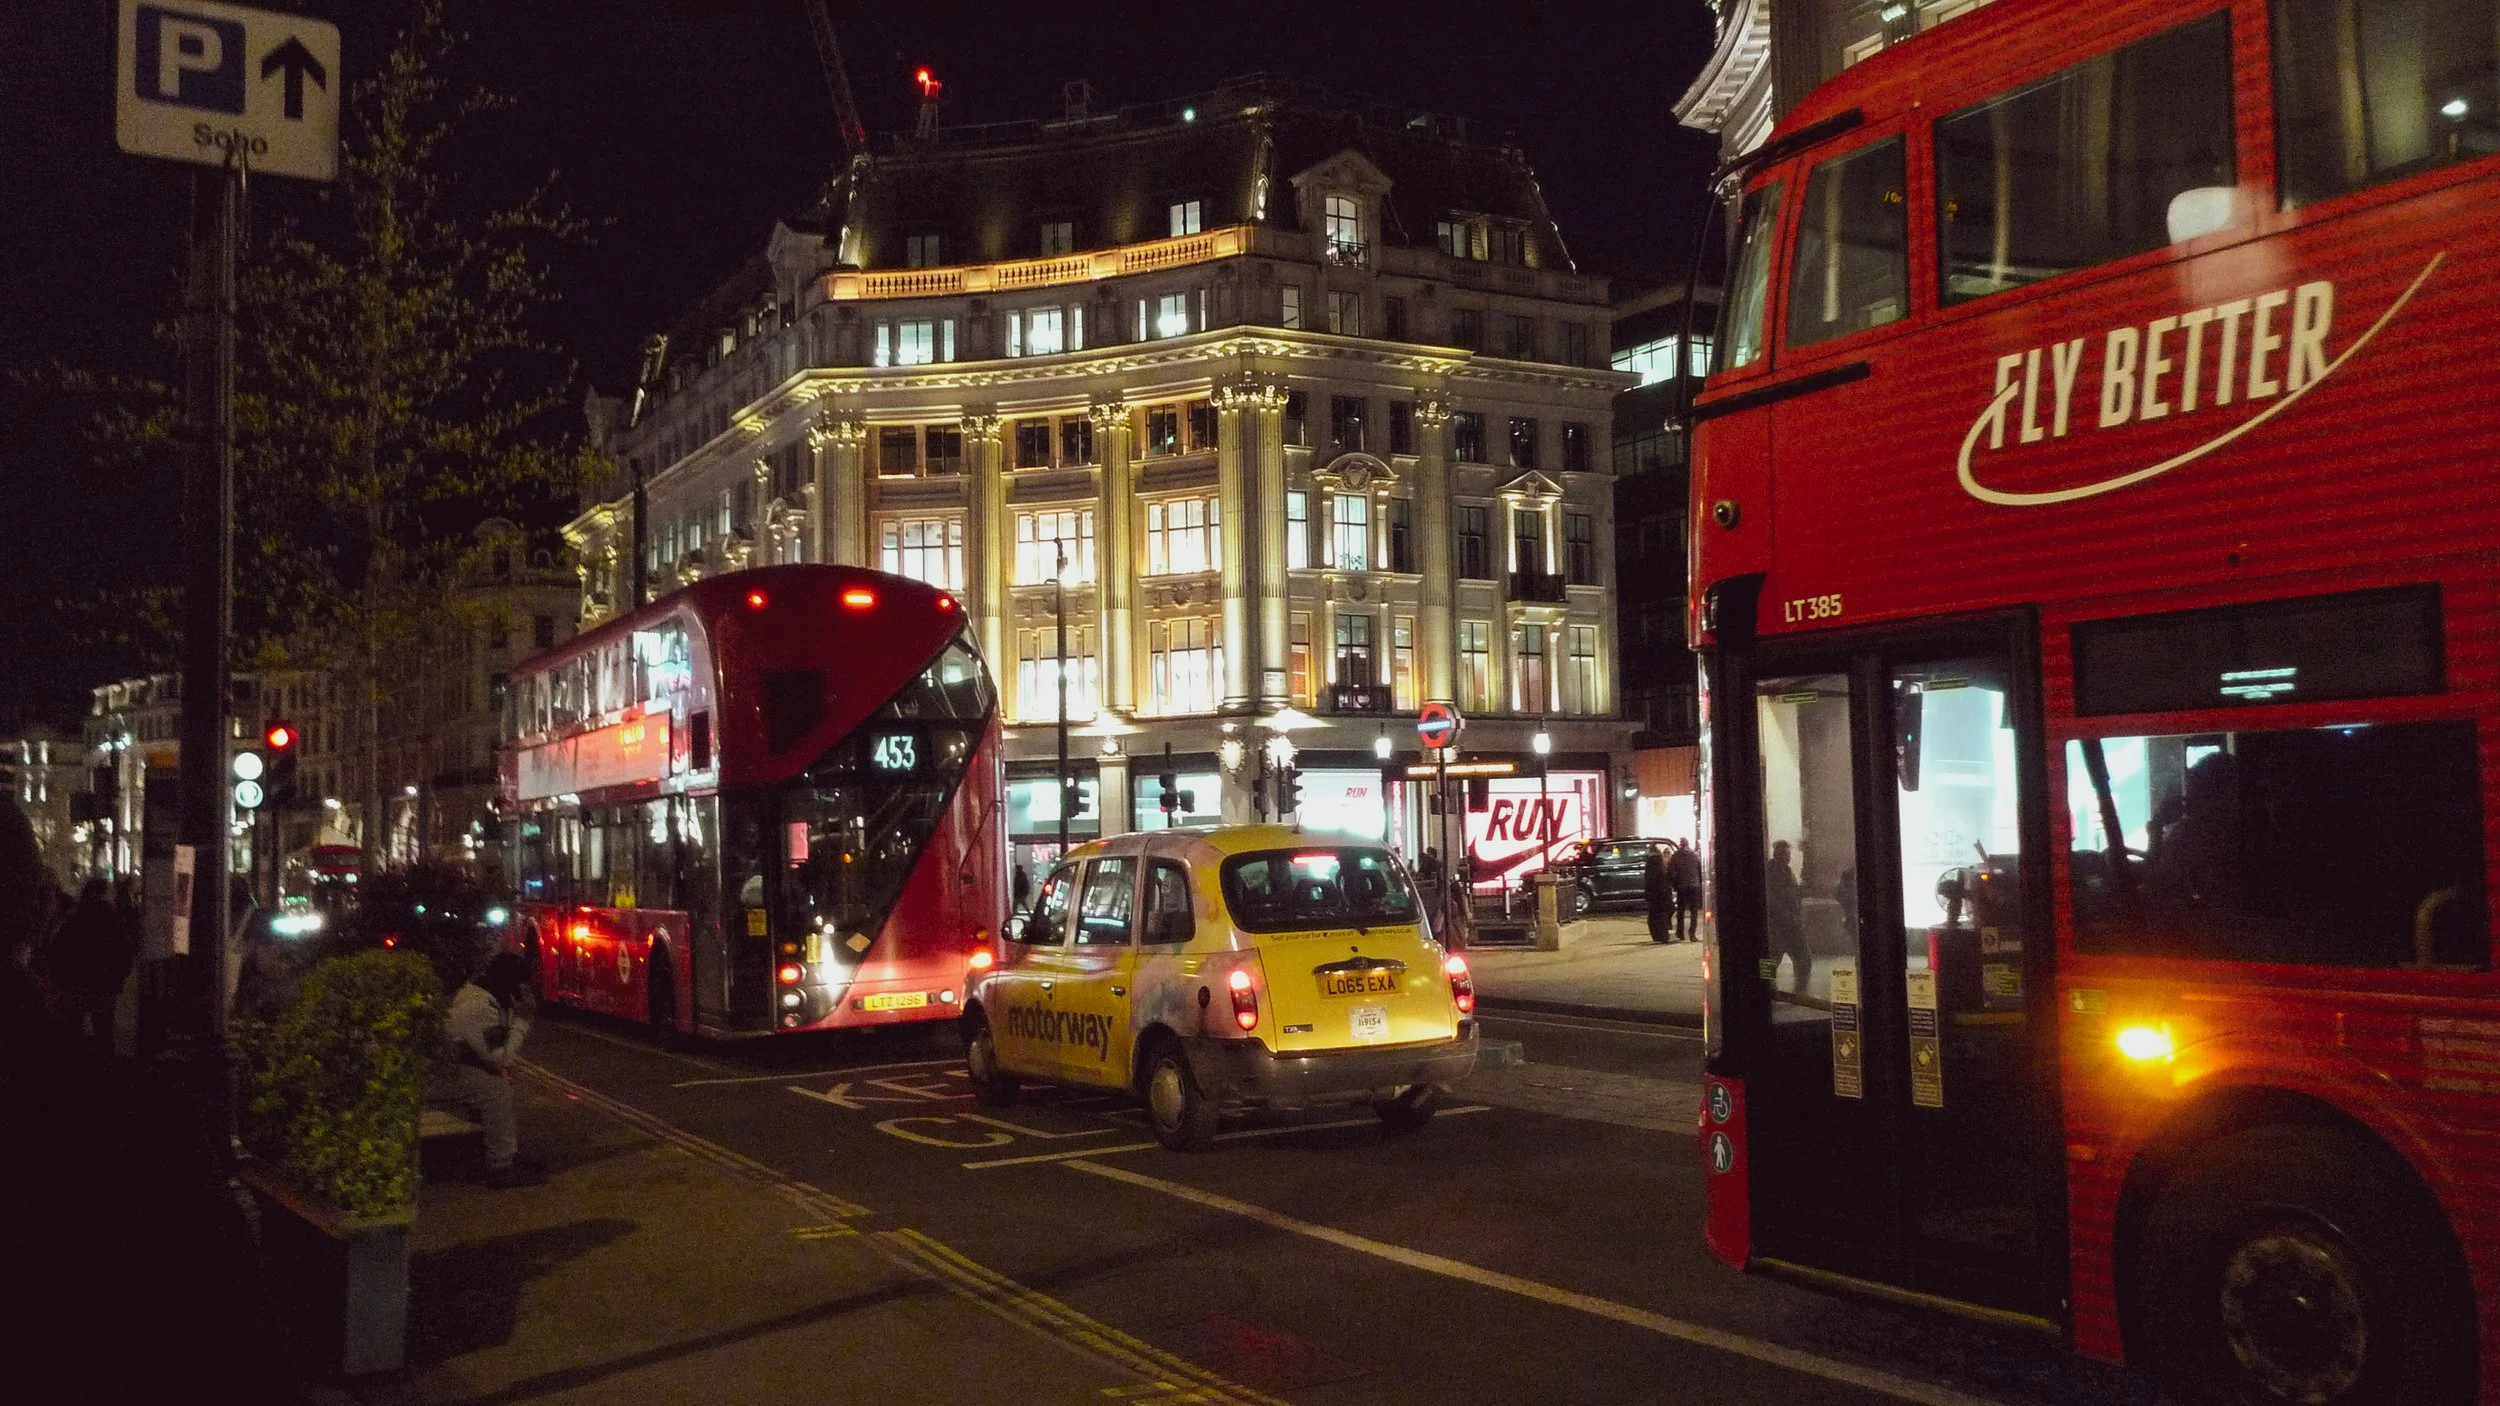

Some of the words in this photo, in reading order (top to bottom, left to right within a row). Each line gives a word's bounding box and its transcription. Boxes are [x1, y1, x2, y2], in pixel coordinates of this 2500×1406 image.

[159, 16, 223, 98] P
[193, 122, 269, 155] Soho
[1989, 338, 2085, 449] FLY
[2100, 280, 2334, 428] BETTER
[874, 735, 915, 768] 453
[1346, 787, 1368, 798] RUN
[1485, 799, 1568, 841] RUN
[1368, 976, 1396, 992] EXA
[1007, 1001, 1113, 1062] motorway
